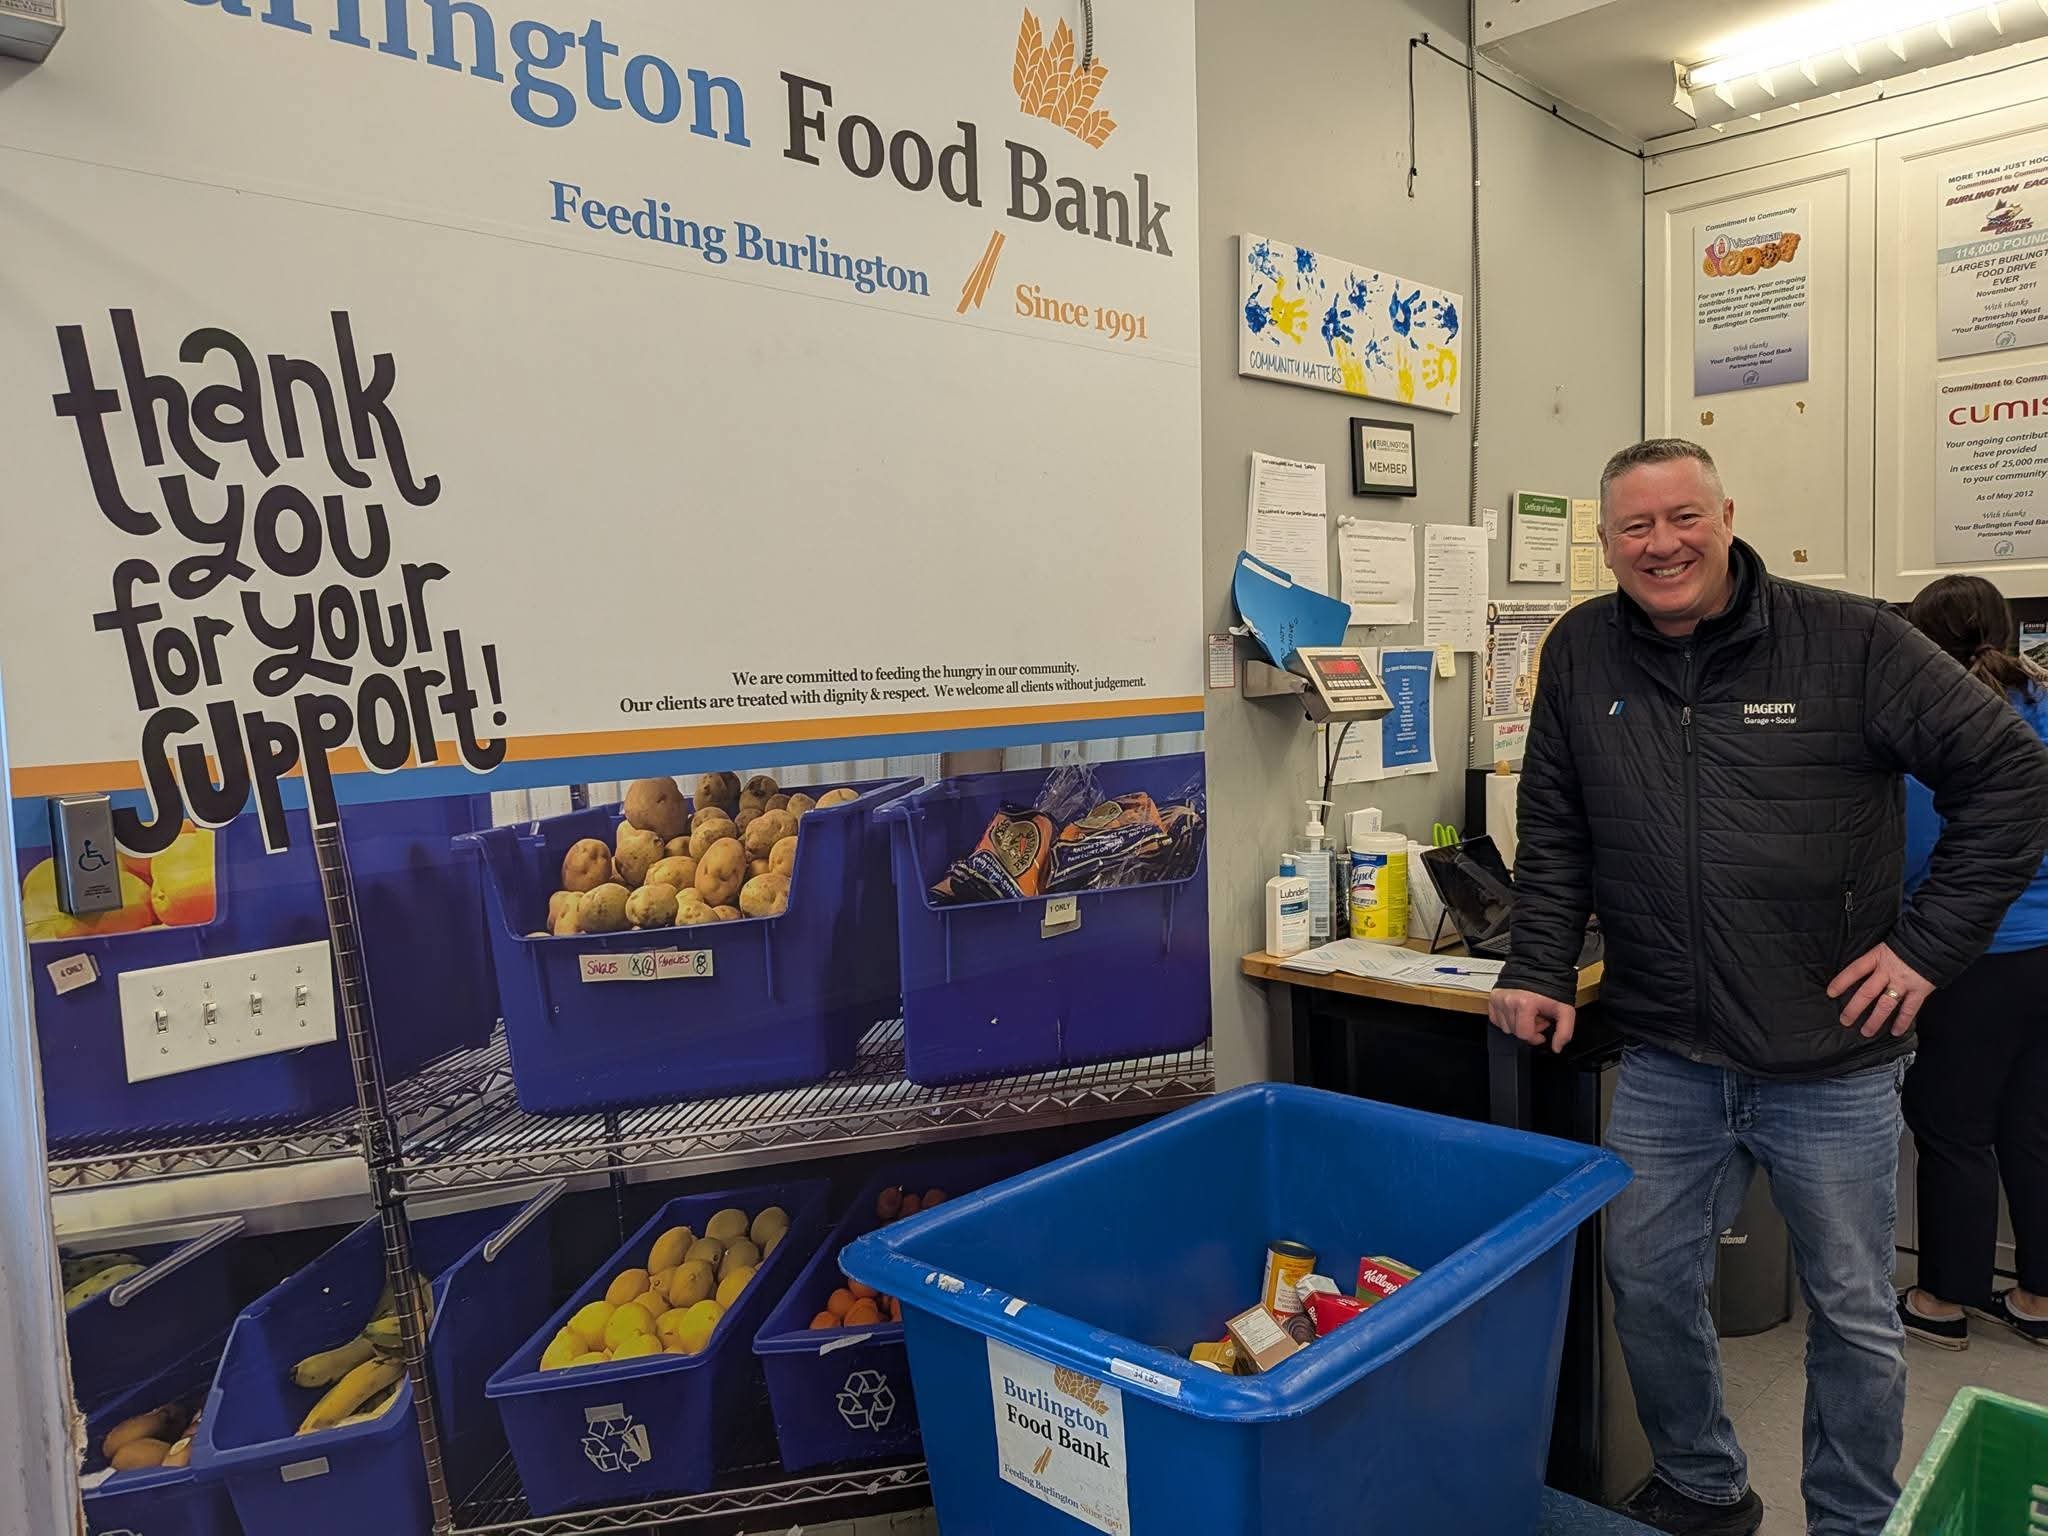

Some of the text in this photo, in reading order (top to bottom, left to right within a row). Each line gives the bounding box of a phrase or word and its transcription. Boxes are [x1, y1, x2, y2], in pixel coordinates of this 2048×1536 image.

[780, 70, 983, 209] Food
[1004, 138, 1173, 257] Bank
[1948, 160, 2027, 184] MORE THAN JUST
[1945, 183, 2020, 207] BURLINGTON
[1705, 215, 1748, 232] Commitment
[1757, 206, 1798, 221] Community
[549, 180, 931, 298] Feeding Burlington
[1955, 242, 2000, 259] 114,000
[1950, 258, 1997, 274] LARGEST
[1976, 261, 2037, 279] FOOD DRIVE
[1697, 292, 1709, 301] For
[1710, 291, 1726, 299] over
[1727, 288, 1735, 296] 15
[1758, 281, 1774, 291] your
[1774, 275, 1807, 287] on-going
[1976, 281, 2037, 298] November 2011
[1992, 274, 2020, 287] EVER
[1698, 296, 1742, 309] contributions
[1744, 291, 1760, 300] have
[1761, 286, 1795, 298] permitted
[1706, 305, 1732, 317] provide
[1733, 303, 1748, 312] your
[1749, 298, 1772, 309] quality
[1773, 292, 1805, 304] products
[1015, 284, 1149, 343] Since 1991
[1726, 311, 1744, 321] most
[1744, 309, 1752, 317] in
[1752, 306, 1770, 316] need
[1770, 302, 1792, 312] within
[1793, 300, 1806, 308] our
[1971, 306, 2041, 324] Partnership West
[1712, 316, 1748, 330] Burlington
[1974, 319, 2014, 332] Burlington
[2015, 315, 2036, 324] Food
[1758, 350, 1775, 358] Food
[1776, 347, 1792, 355] Bank
[1250, 350, 1342, 384] COMMUNITY MATTERS
[1941, 379, 2001, 394] Commitment
[2003, 379, 2013, 387] to
[52, 308, 441, 536] thank
[1945, 440, 1965, 449] Your
[1966, 436, 2004, 448] ongoing
[1973, 444, 2037, 459] have provided
[1369, 461, 1408, 475] MEMBER
[1960, 463, 1988, 472] excess
[1989, 461, 1999, 470] of
[2001, 457, 2033, 469] 25,000
[1963, 468, 2048, 485] to your community
[1976, 490, 2034, 502] As of May 2012
[1972, 521, 2012, 531] Burlington
[2013, 519, 2034, 527] Food
[160, 474, 390, 600] you
[93, 559, 451, 711] for your
[732, 661, 1080, 685] We are committed to feeding the hungry in our community.
[620, 676, 1146, 713] Our clients are treated with dignity & respect. We welcome all clients without judgement.
[1744, 703, 1796, 714] HAGERTY
[1744, 716, 1770, 725] Garage
[1775, 716, 1797, 724] Social
[114, 629, 507, 854] support!
[1054, 902, 1071, 912] ONLY
[1002, 1376, 1110, 1440] Burlington
[1006, 1402, 1111, 1469] Food Bank
[1004, 1463, 1035, 1488] Feeding
[1035, 1480, 1079, 1509] Burlington
[1080, 1503, 1103, 1521] Since
